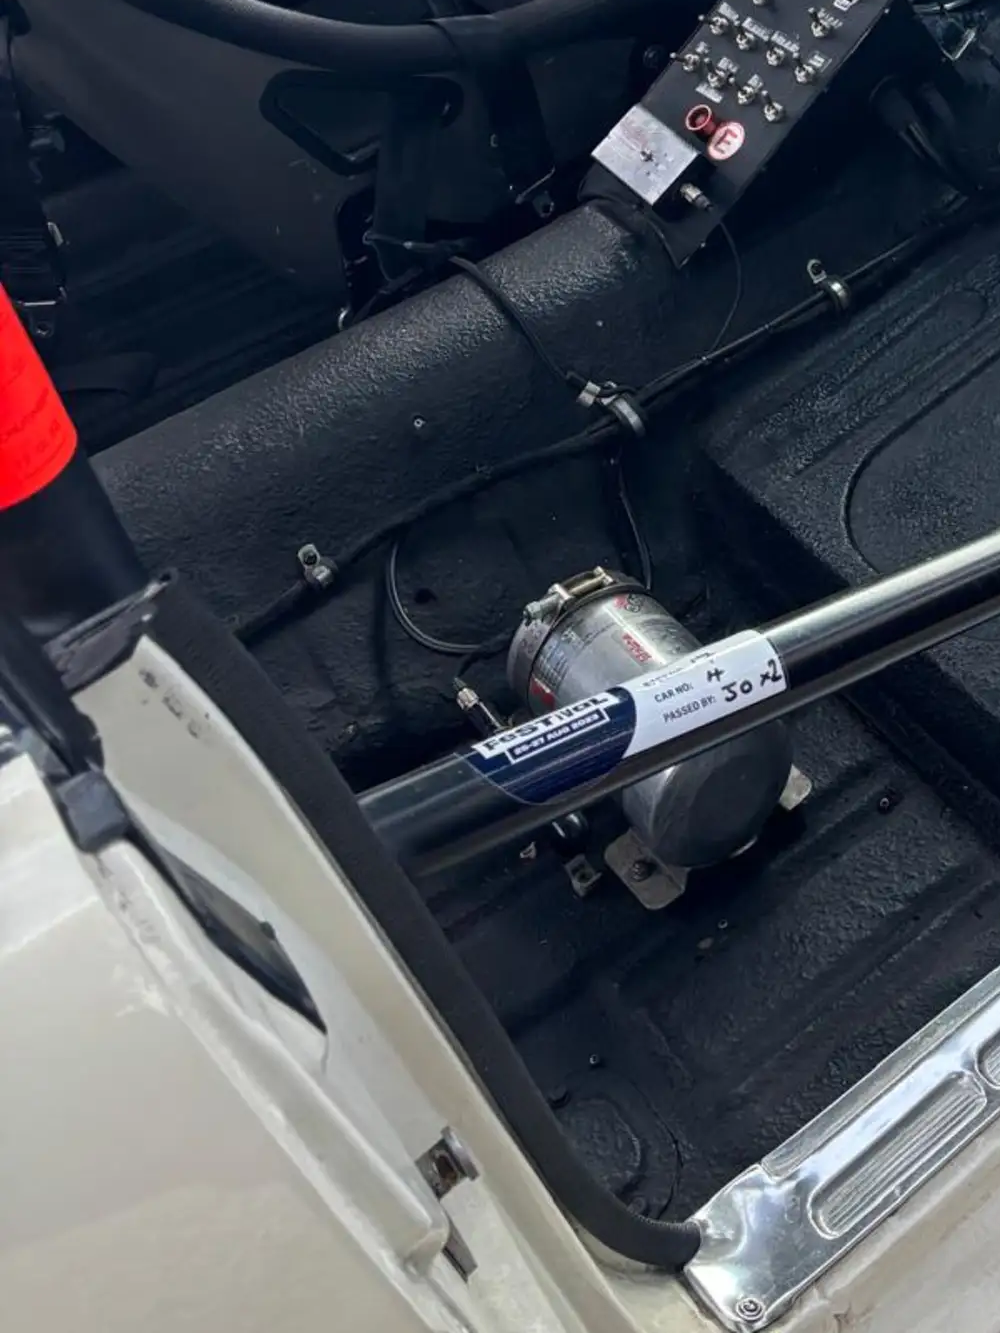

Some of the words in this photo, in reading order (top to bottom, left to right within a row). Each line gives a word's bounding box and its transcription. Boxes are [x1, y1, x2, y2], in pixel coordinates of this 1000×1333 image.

[714, 126, 738, 155] E
[653, 688, 676, 703] CAR
[662, 700, 701, 723] PASSED
[545, 726, 571, 741] AUG
